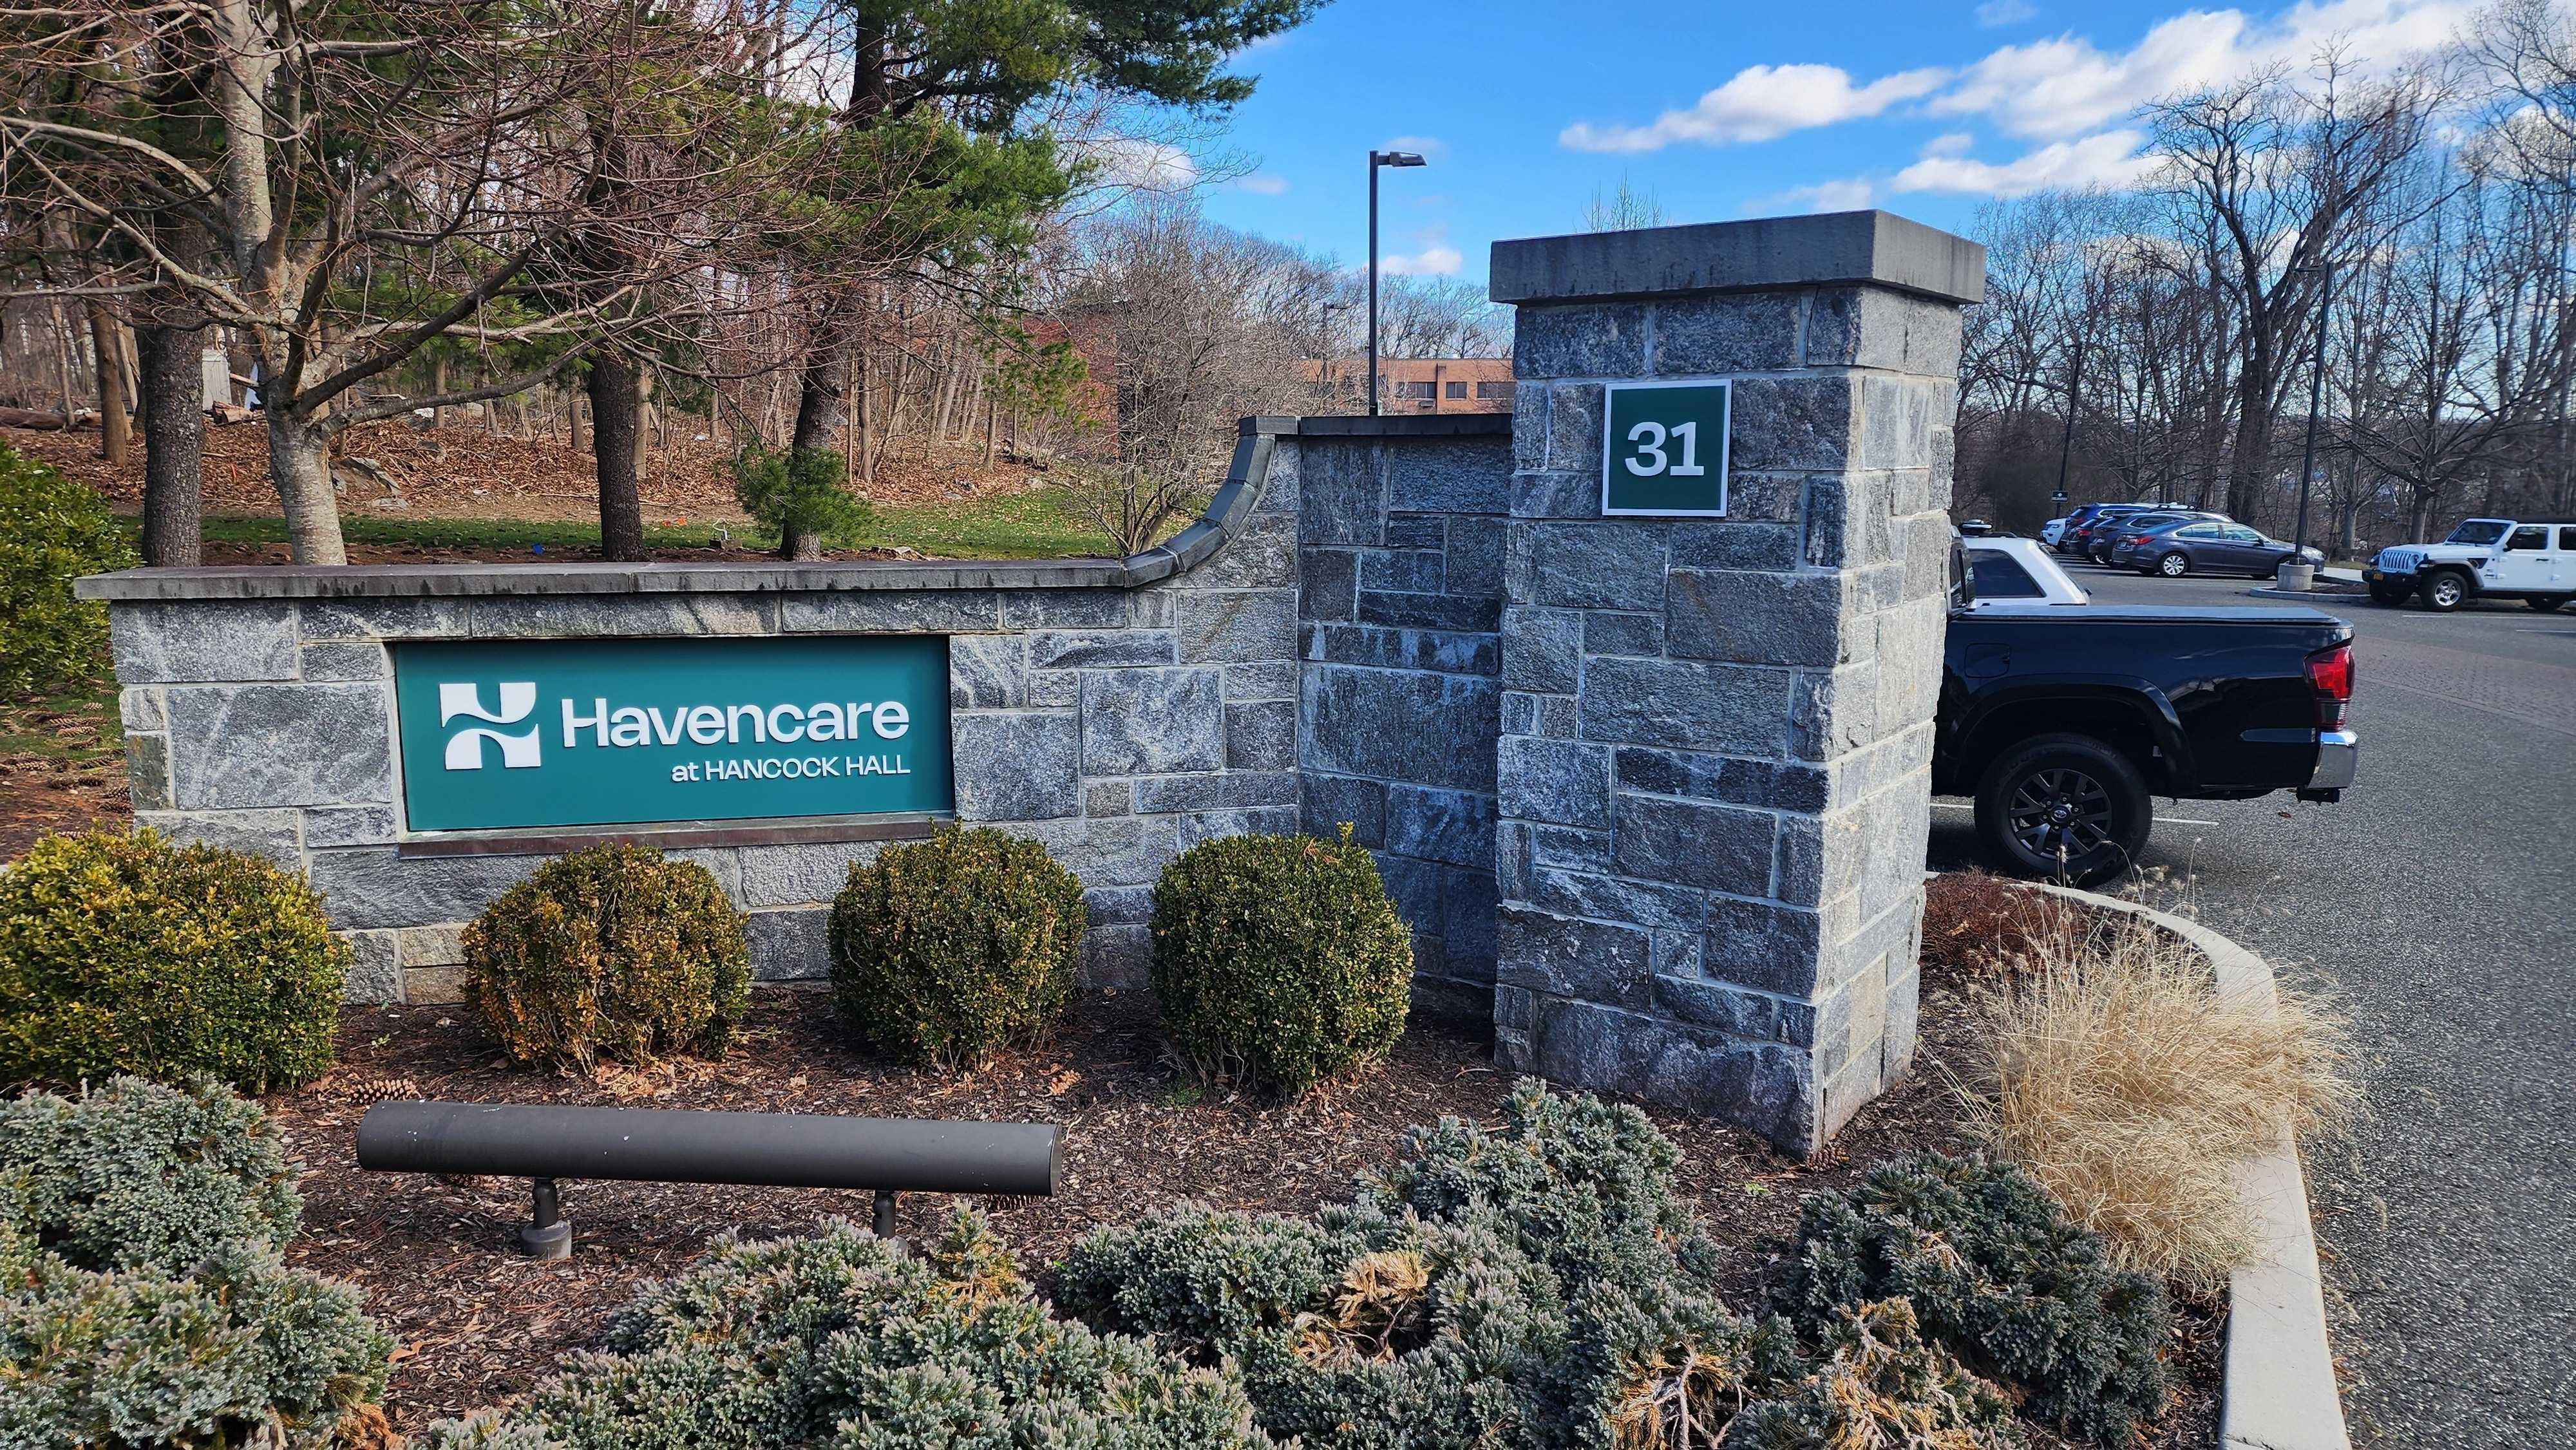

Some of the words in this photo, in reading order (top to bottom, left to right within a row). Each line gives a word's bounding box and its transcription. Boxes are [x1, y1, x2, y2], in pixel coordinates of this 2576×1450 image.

[1625, 422, 1705, 476] 31
[562, 697, 909, 748] Havencare
[672, 760, 700, 782] at
[705, 757, 841, 780] HANCOCK
[846, 755, 911, 777] HALL
